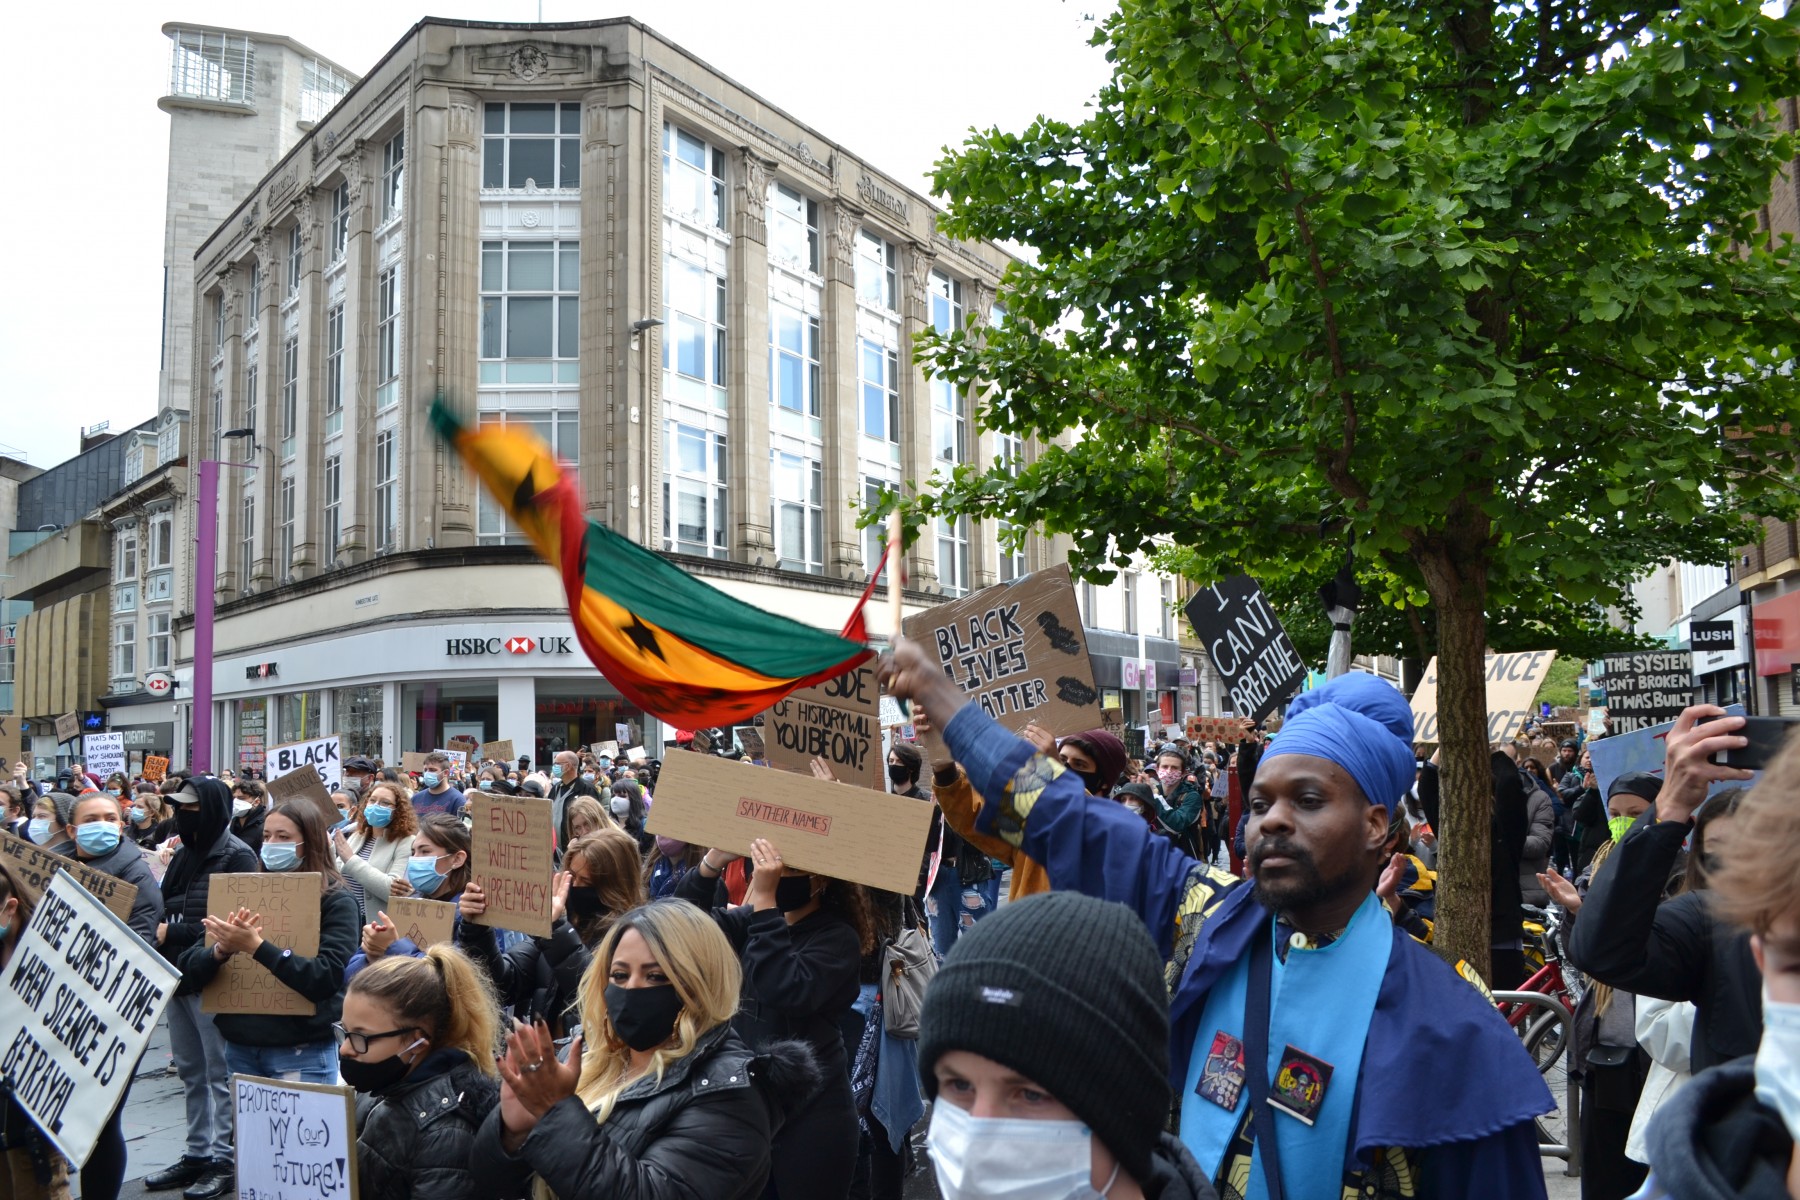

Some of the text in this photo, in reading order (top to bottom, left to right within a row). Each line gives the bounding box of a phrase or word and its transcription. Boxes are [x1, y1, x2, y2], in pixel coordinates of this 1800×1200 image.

[446, 636, 573, 655] HSBC UK
[935, 602, 1025, 663] BLACK
[1692, 629, 1733, 642] LUSH
[943, 639, 1028, 692] LIVES
[1230, 632, 1301, 718] BREATHE
[1605, 657, 1630, 673] THE
[1633, 652, 1691, 673] SYSTEM
[1638, 674, 1690, 689] BROKEN
[970, 679, 1049, 719] ATTER
[1608, 692, 1693, 709] IT WAS BUILT
[773, 700, 793, 717] OF
[798, 703, 847, 731] HISTORY
[124, 730, 147, 745] COVENTRY
[773, 719, 807, 753] YOU
[278, 742, 339, 771] BLACK
[490, 807, 527, 835] END
[740, 801, 828, 832] SAY THEIR NAMES
[489, 842, 528, 870] WHITE
[79, 868, 117, 898] THIS
[227, 876, 305, 894] RESPECT
[236, 896, 291, 912] BLACK
[396, 902, 446, 920] THE UK IS
[31, 888, 163, 1034] THERE COMES A TIME
[218, 992, 296, 1009] CULTURE
[9, 946, 126, 1086] WHEN SILENCE IS
[0, 1025, 76, 1136] BETRAYAL
[238, 1084, 300, 1115] PROTECT
[269, 1117, 291, 1149] MY
